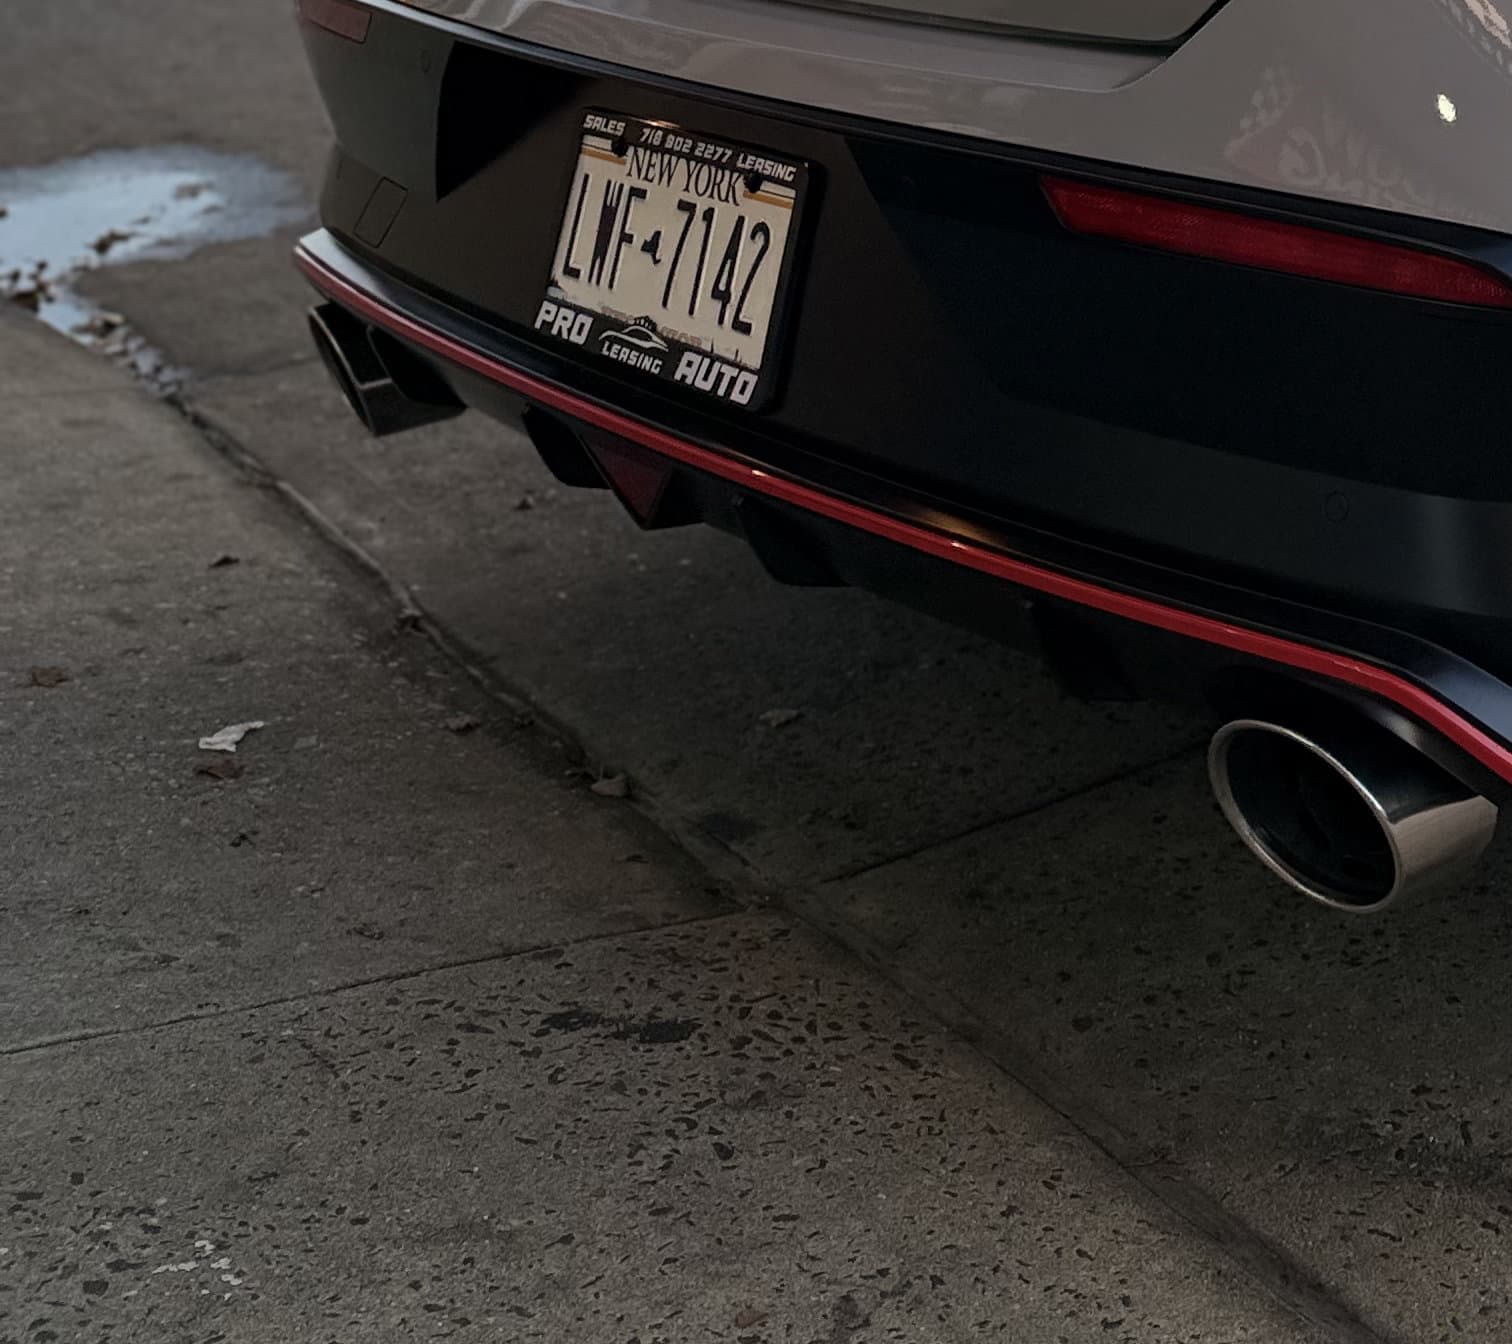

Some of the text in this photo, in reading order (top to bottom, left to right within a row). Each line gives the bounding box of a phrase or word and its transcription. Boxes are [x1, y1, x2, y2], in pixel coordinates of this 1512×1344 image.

[583, 114, 798, 182] SALES 718 802 2277 LEASING
[626, 145, 741, 207] NEW YORK
[533, 300, 594, 346] PRO
[601, 341, 664, 375] LEASING
[674, 351, 759, 406] AUTO
